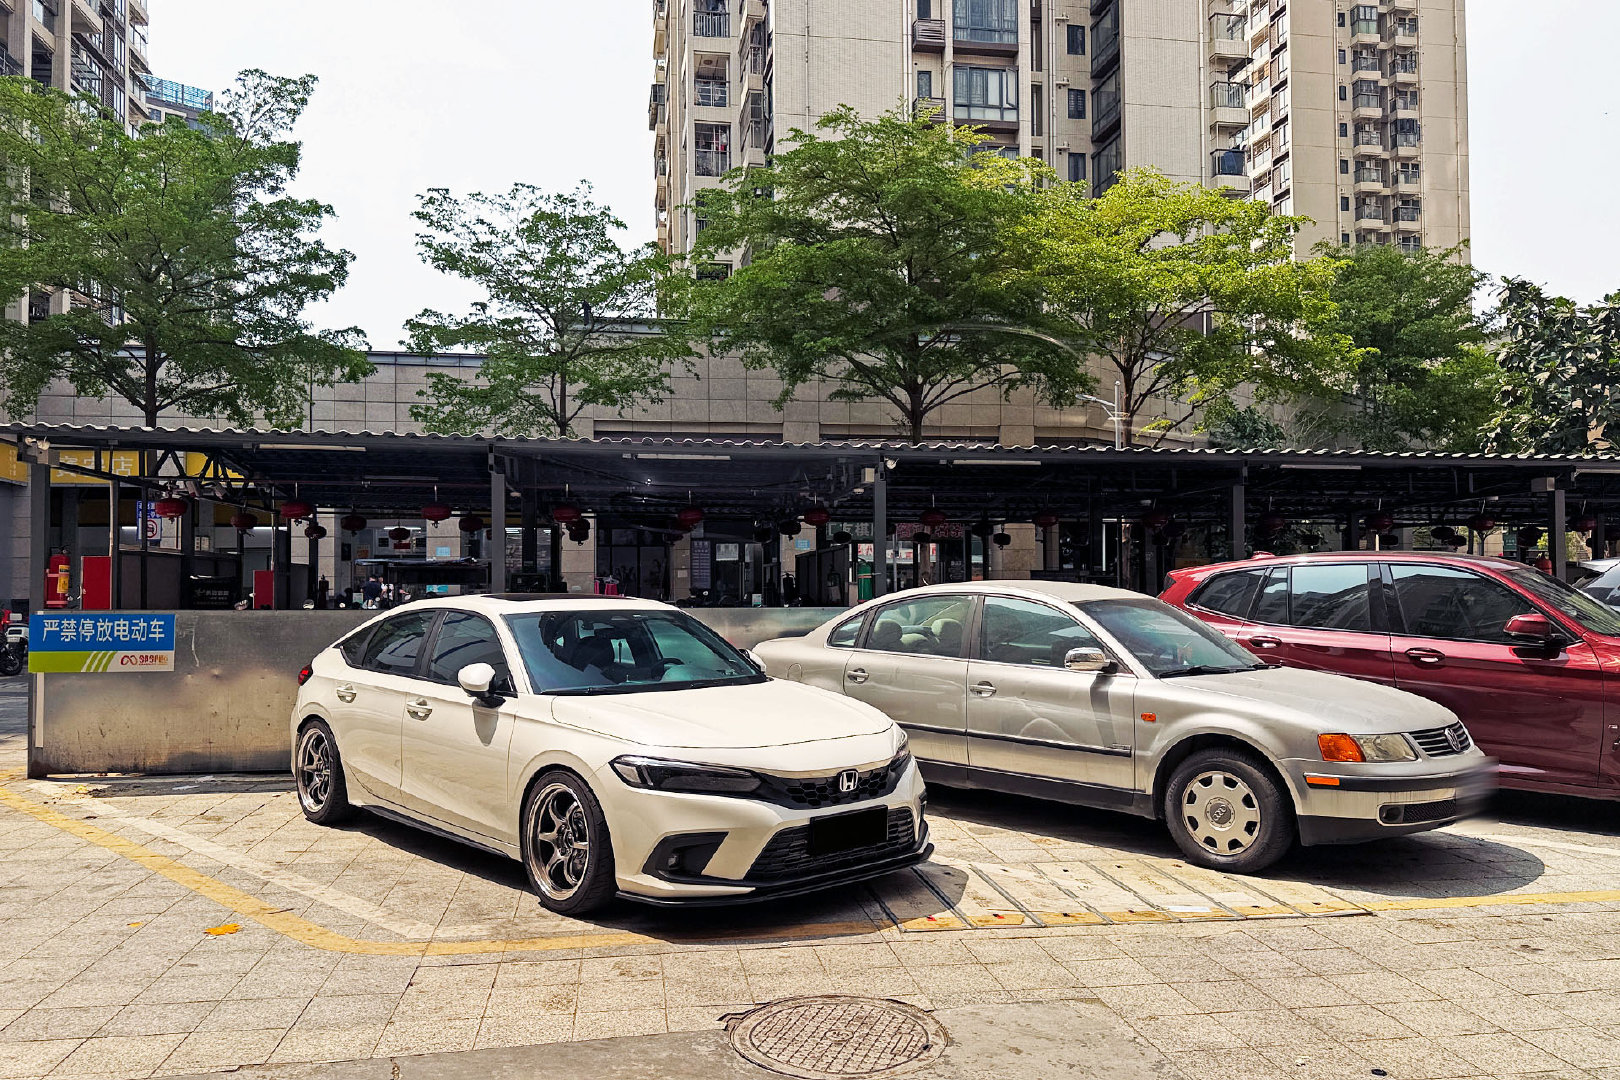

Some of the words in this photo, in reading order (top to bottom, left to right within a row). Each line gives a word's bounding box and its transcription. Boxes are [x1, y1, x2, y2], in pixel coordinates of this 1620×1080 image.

[42, 618, 165, 643] 严禁停放电动车
